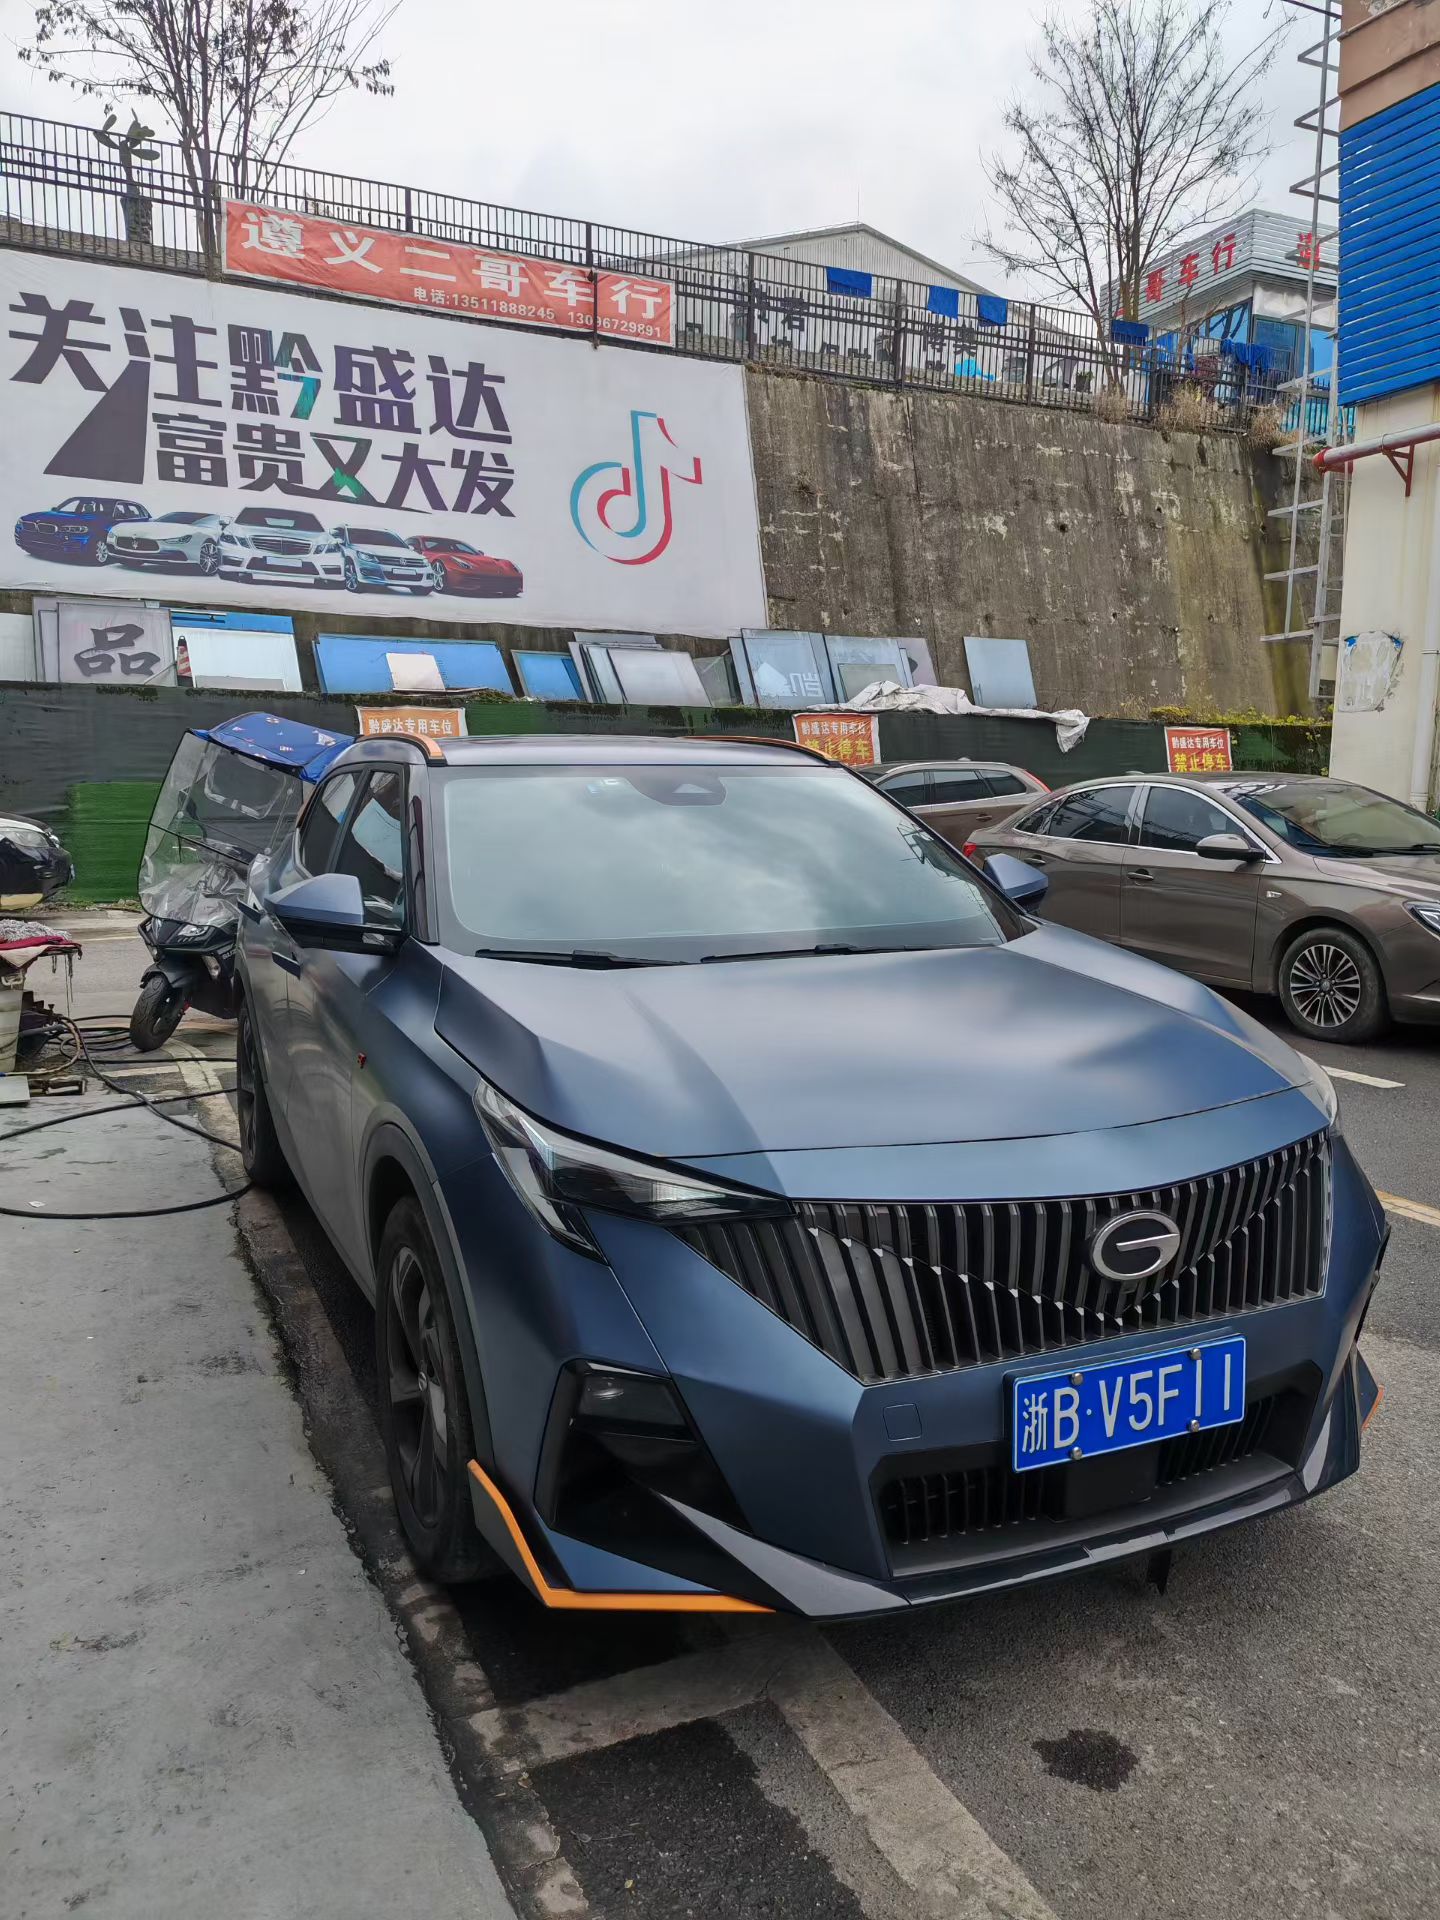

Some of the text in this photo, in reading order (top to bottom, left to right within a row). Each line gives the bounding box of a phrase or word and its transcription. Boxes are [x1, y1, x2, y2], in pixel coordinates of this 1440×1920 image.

[241, 212, 662, 319] 遵义二哥车行
[8, 291, 513, 484] 关注黔盛达
[152, 412, 517, 518] 富贵又大发
[74, 623, 161, 677] 品
[368, 718, 453, 735] 黔盛达专用车位
[801, 720, 866, 736] 黔盛达专用车位
[1172, 736, 1225, 749] 黔盛达专用车位
[1174, 752, 1228, 773] 禁止停车
